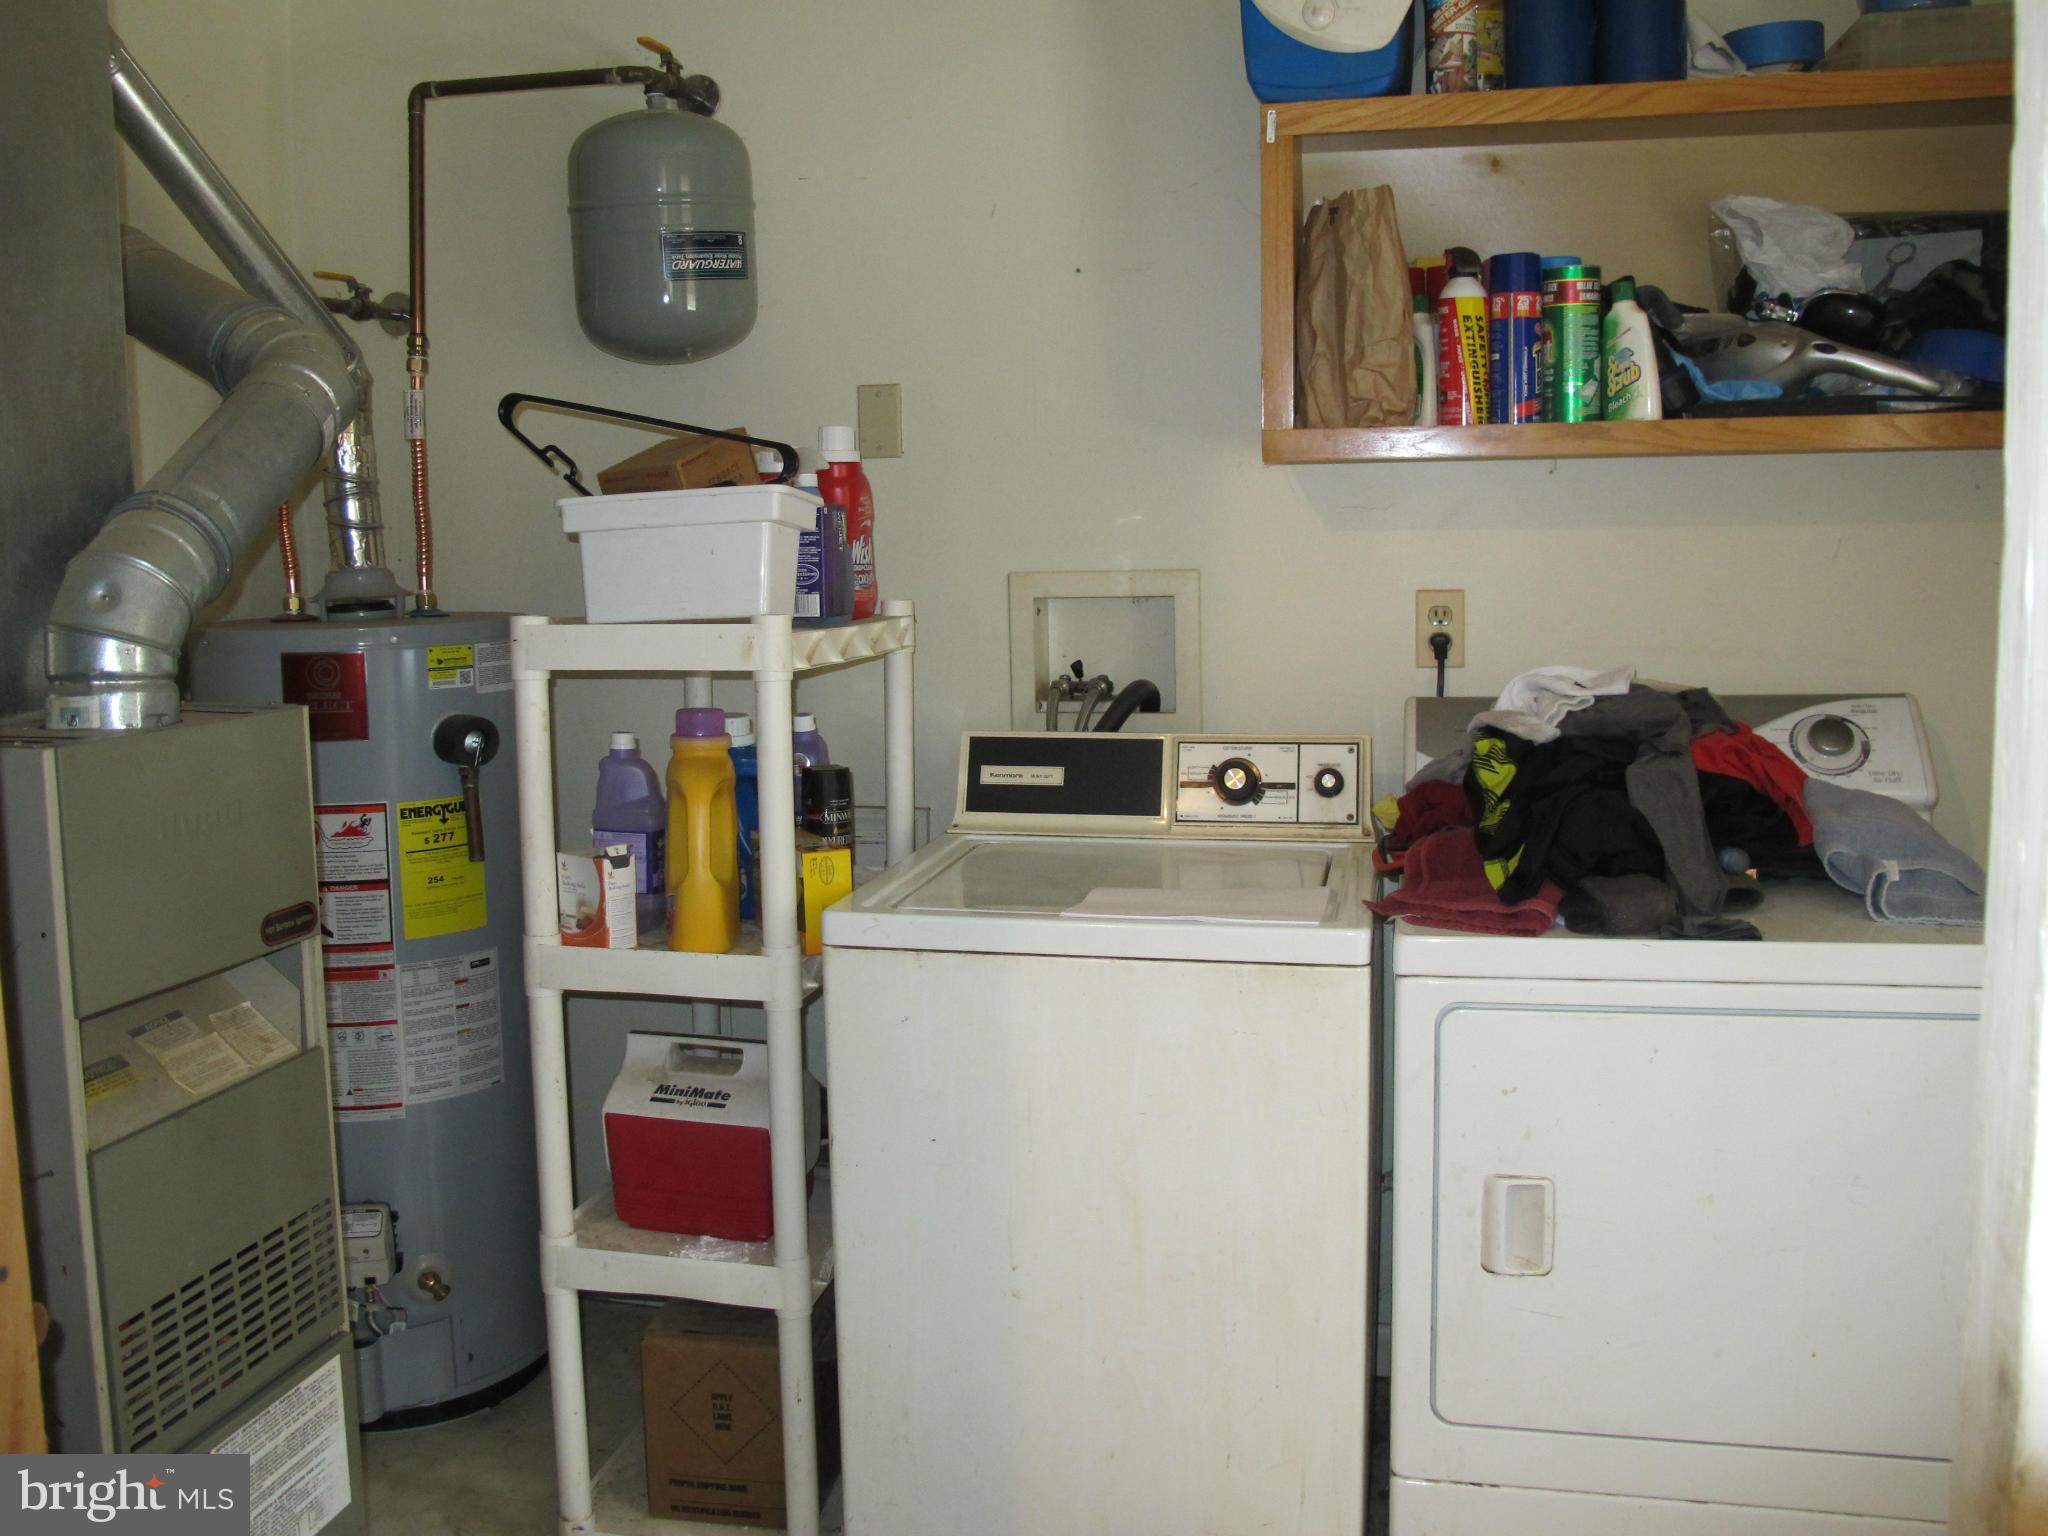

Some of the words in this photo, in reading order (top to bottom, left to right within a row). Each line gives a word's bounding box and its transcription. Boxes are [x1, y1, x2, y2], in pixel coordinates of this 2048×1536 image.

[671, 259, 742, 270] WATERGUARD
[1475, 315, 1488, 370] SAFETY
[1462, 314, 1484, 425] EXTINGUISHER
[433, 832, 455, 844] 277
[427, 876, 444, 885] 254
[654, 1084, 731, 1101] MiniMate
